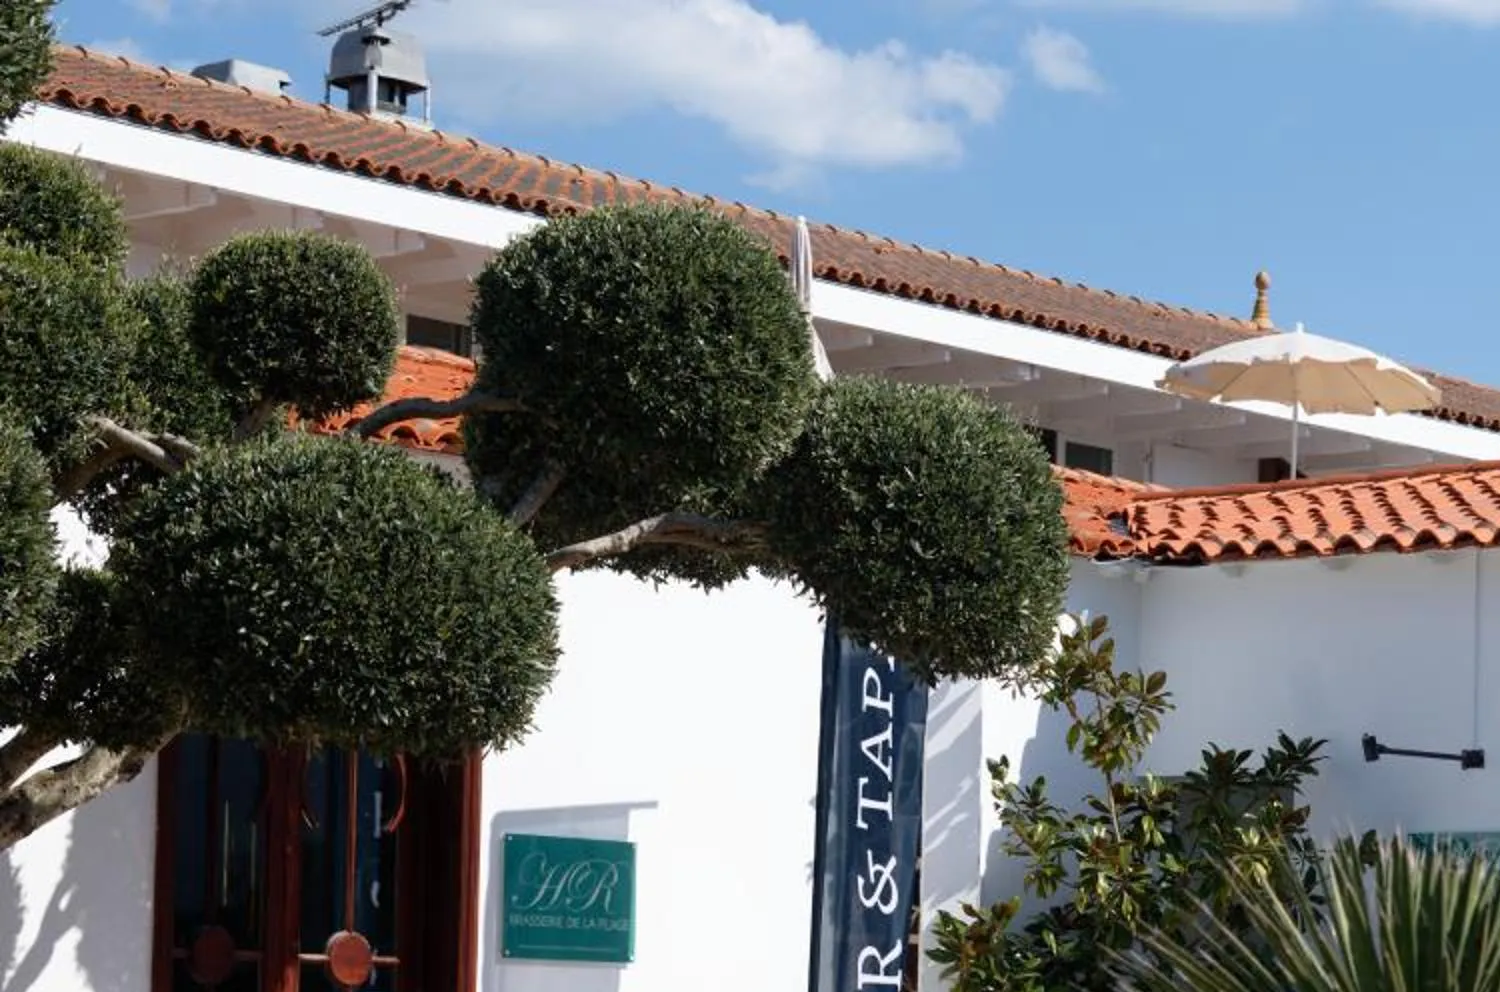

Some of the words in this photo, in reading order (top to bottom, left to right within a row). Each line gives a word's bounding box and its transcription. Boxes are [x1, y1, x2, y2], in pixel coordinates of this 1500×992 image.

[856, 655, 896, 829] TAP
[857, 849, 899, 915] &
[565, 916, 581, 929] DE
